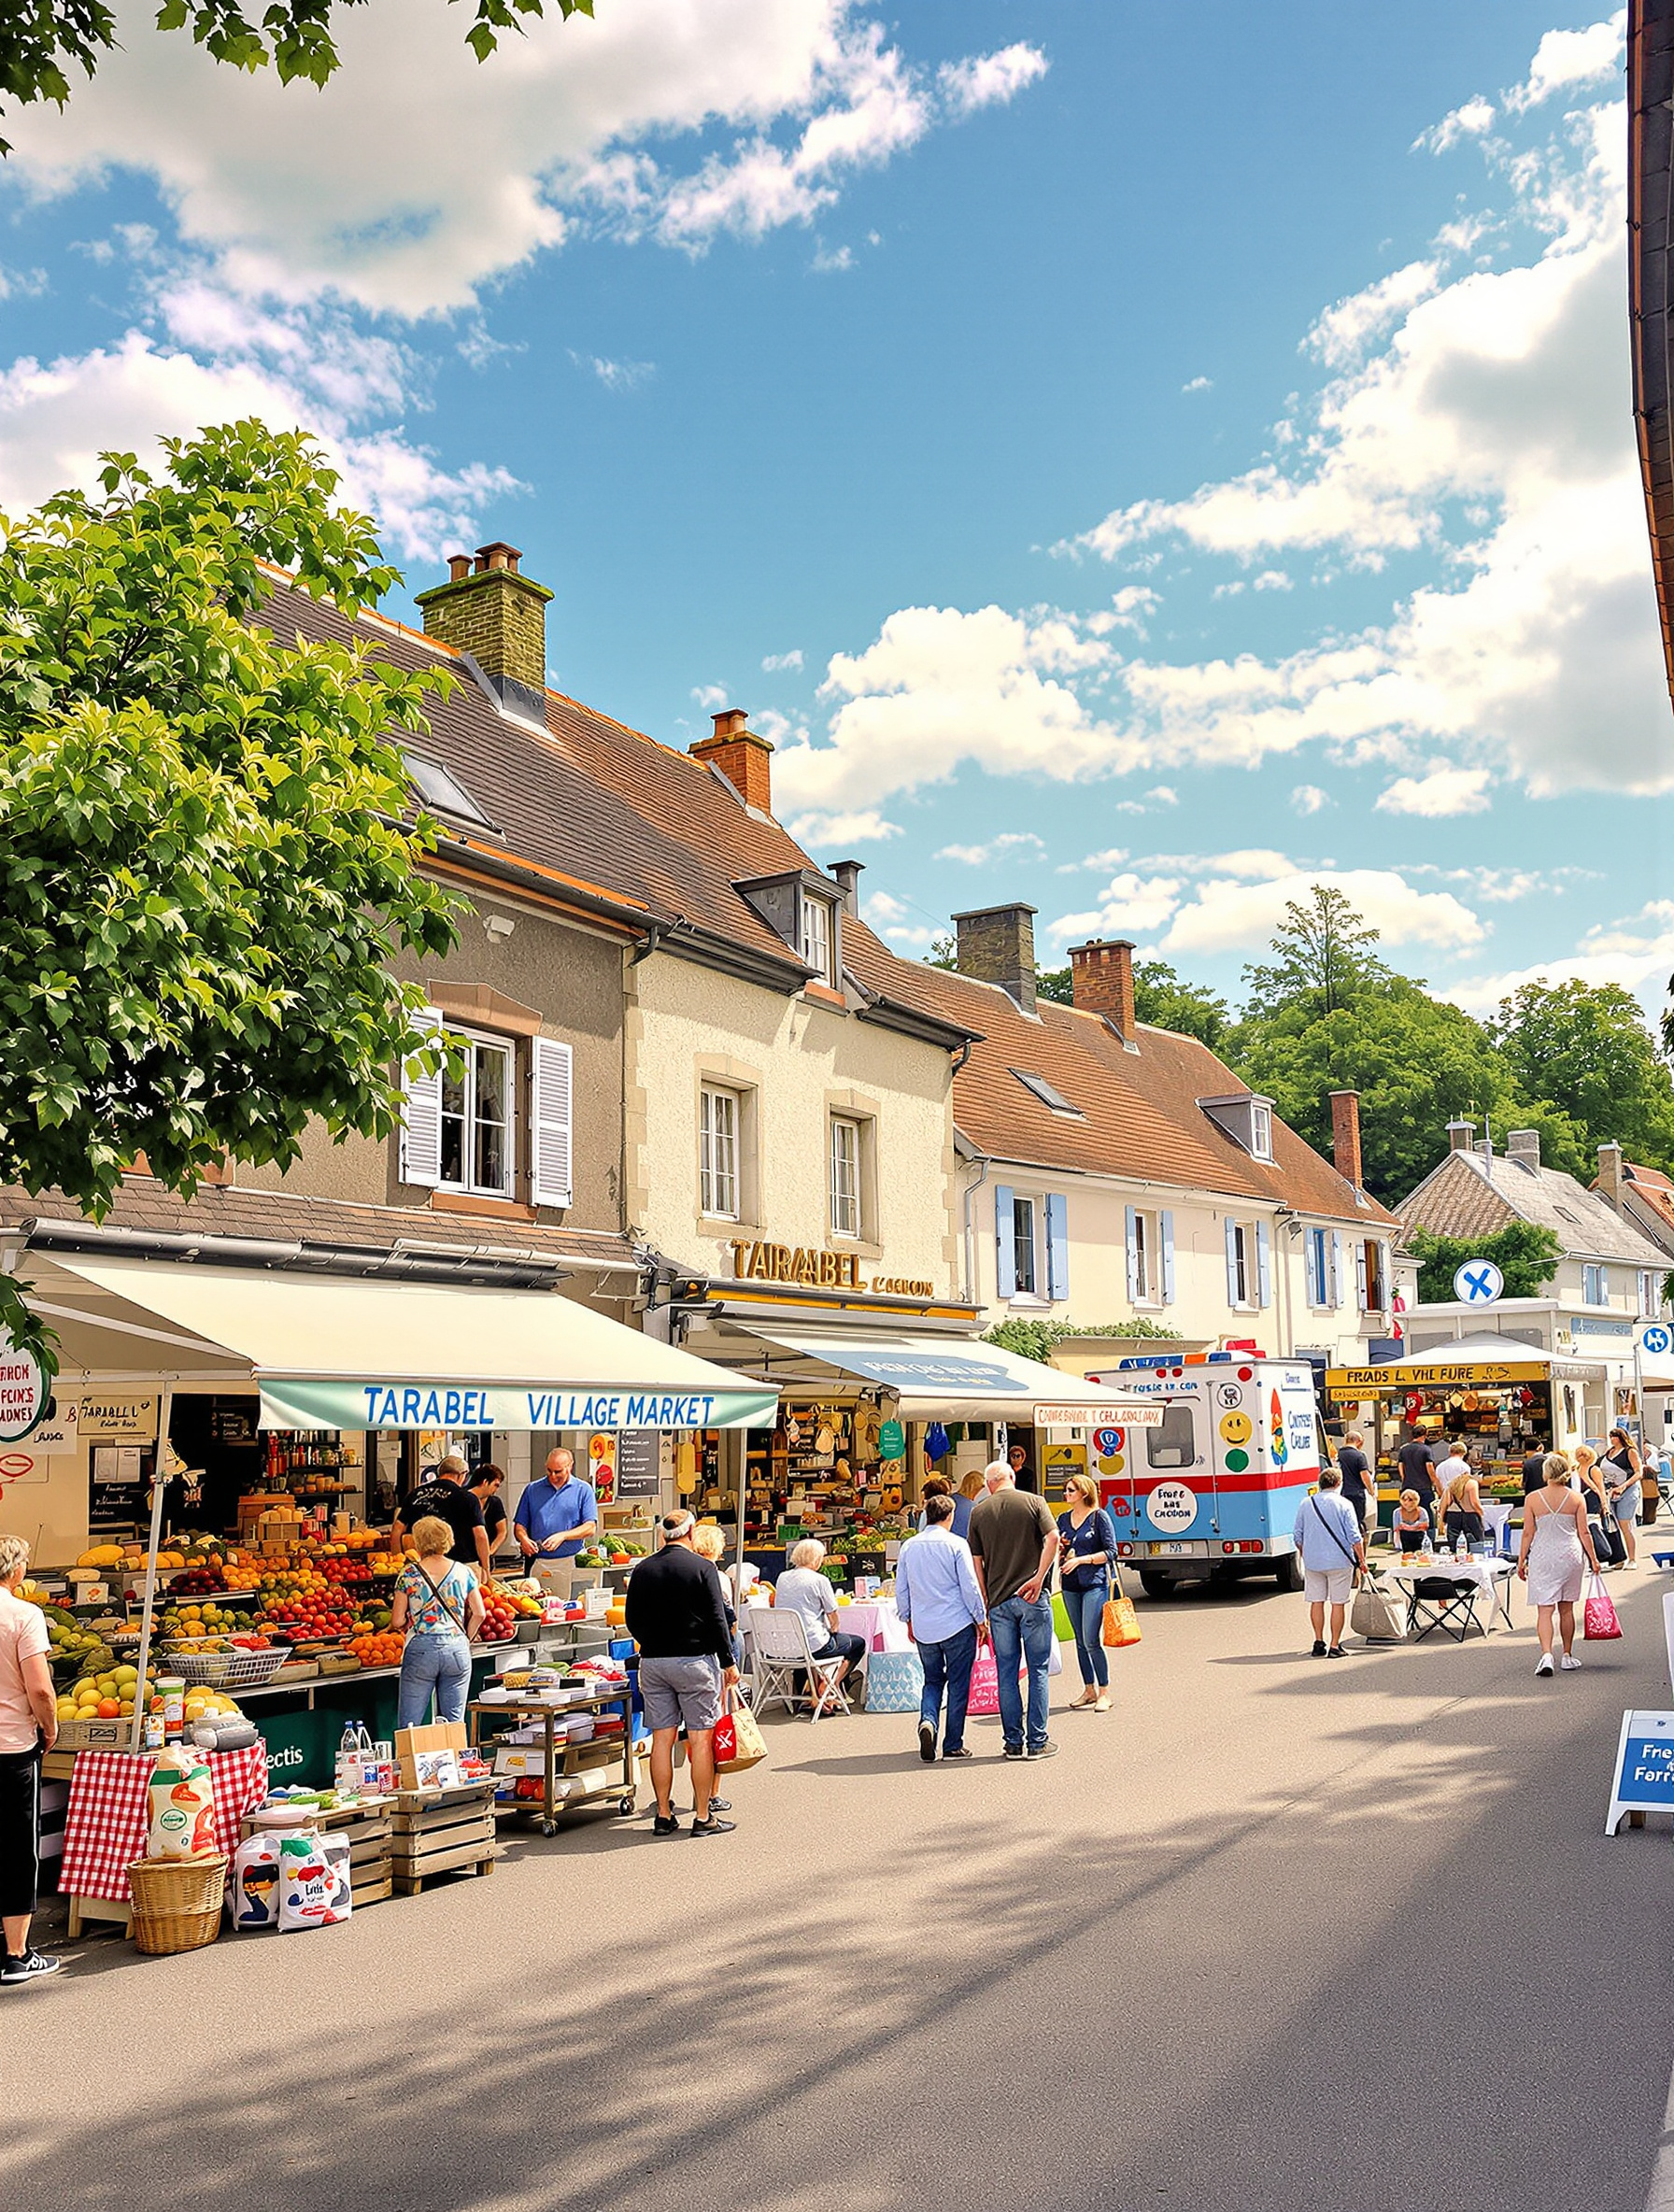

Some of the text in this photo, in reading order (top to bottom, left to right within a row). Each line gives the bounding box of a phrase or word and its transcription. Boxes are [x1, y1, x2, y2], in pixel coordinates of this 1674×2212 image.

[364, 1387, 715, 1426] TARABEL VILLAGE MARKET
[1635, 1766, 1674, 1782] Forr
